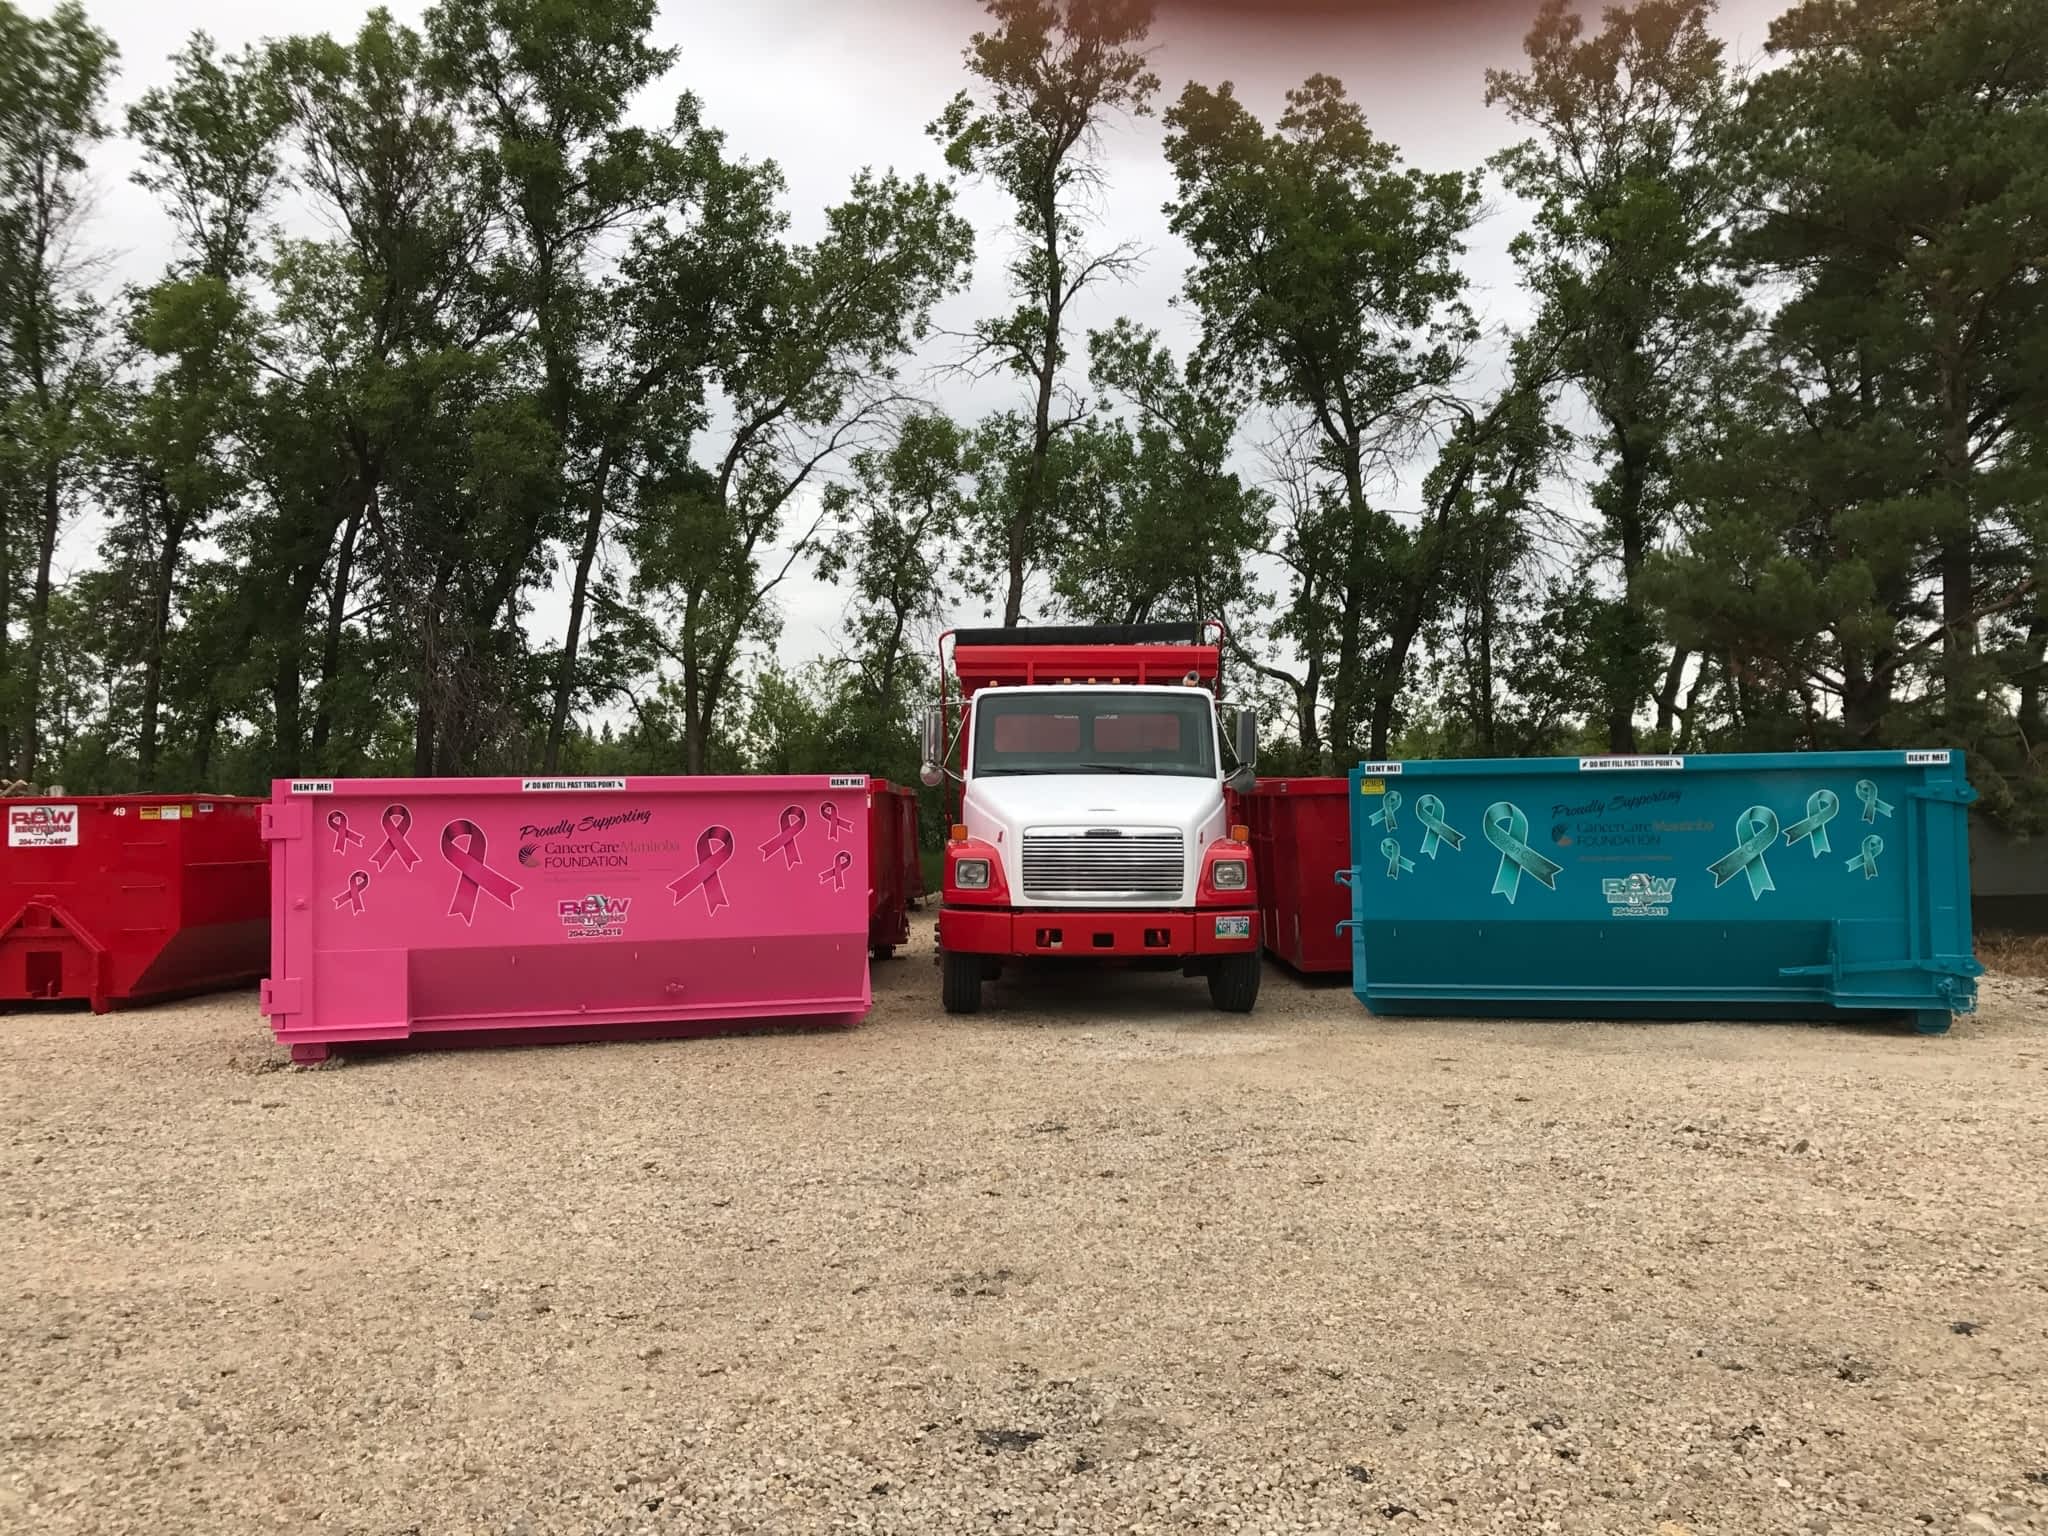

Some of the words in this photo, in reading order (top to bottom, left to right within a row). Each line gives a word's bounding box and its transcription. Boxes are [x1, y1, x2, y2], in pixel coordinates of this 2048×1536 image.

[1908, 754, 1929, 762] RENT
[1612, 760, 1622, 768] FILL
[1366, 765, 1385, 773] RENT
[1386, 765, 1401, 773] ME!
[555, 781, 566, 789] FILL
[831, 778, 849, 786] RENT
[850, 778, 864, 786] ME!
[293, 783, 314, 792] RENT
[316, 783, 332, 791] ME!
[1551, 799, 1606, 820] Proudly
[1608, 789, 1682, 811] Supporting
[113, 807, 126, 816] 49
[520, 819, 575, 840] Proudly
[577, 808, 652, 832] Supporting
[15, 825, 72, 833] RECYCLING
[1576, 835, 1661, 847] FOUNDATION
[544, 855, 629, 868] FOUNDATION
